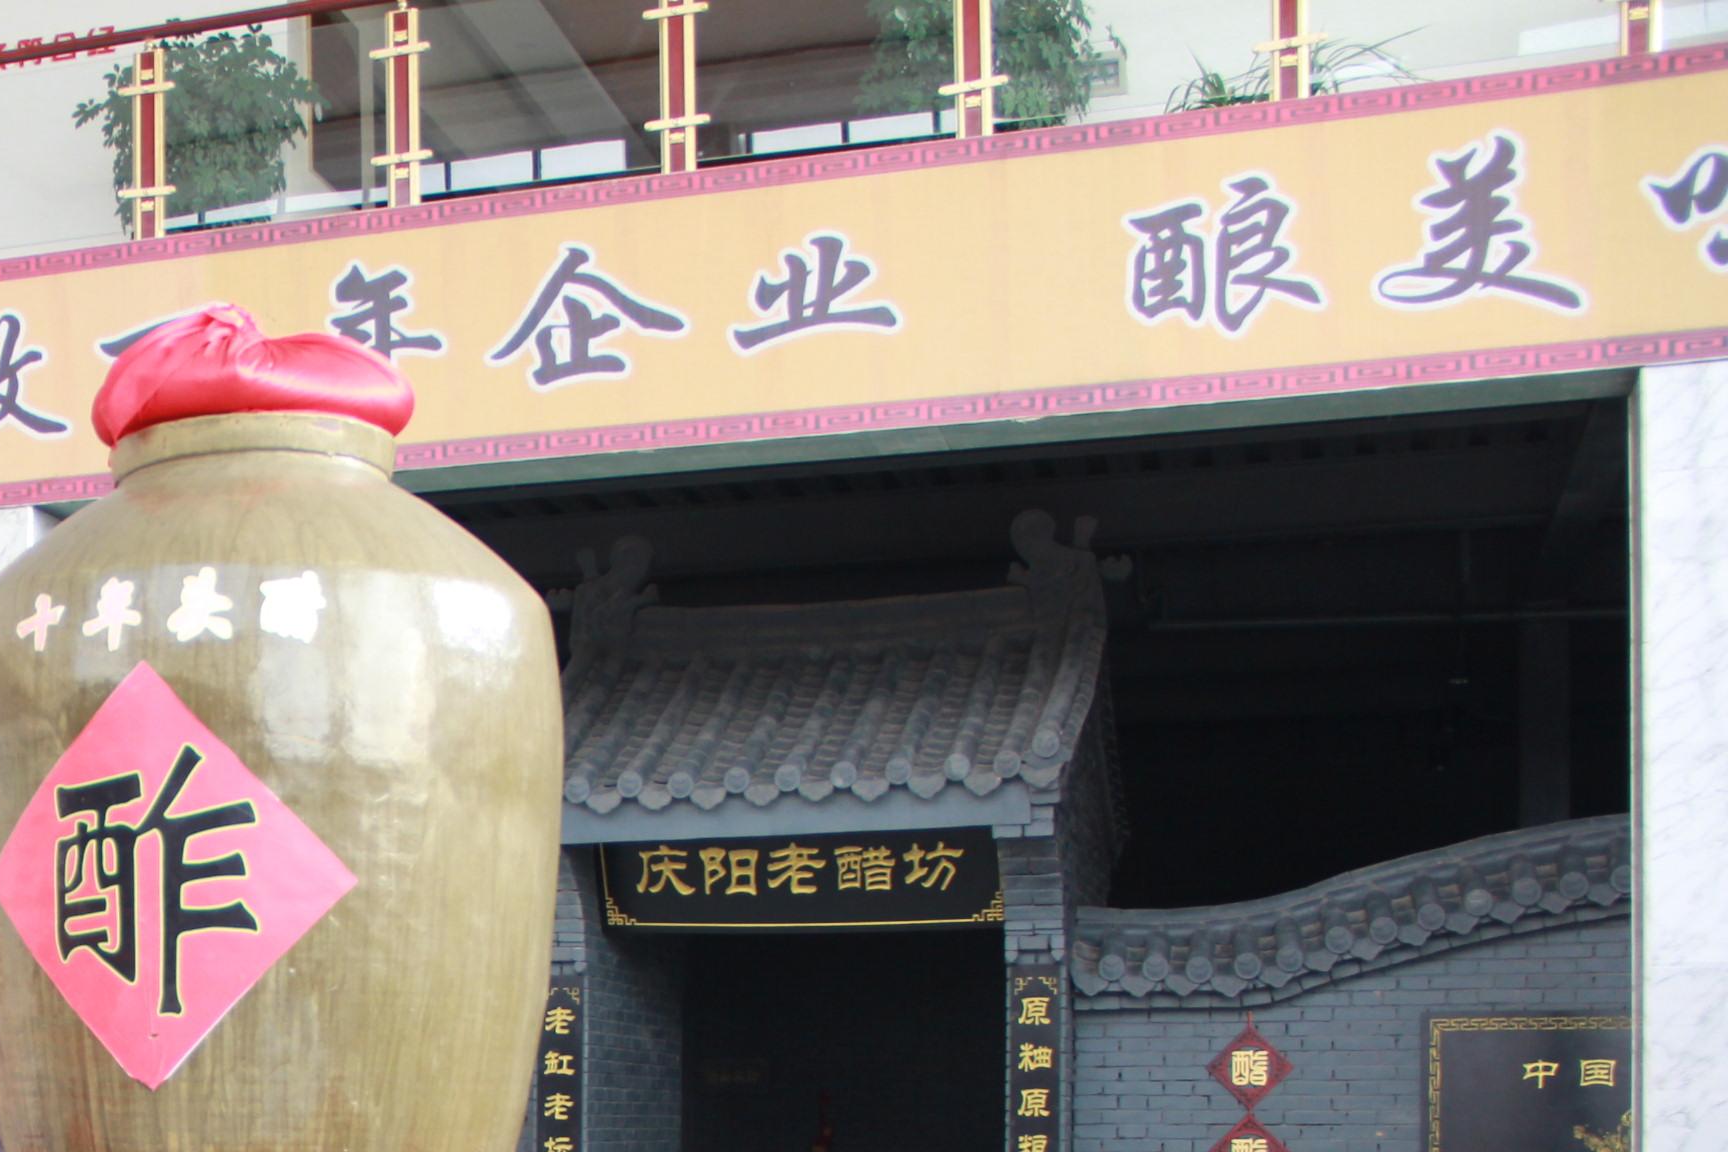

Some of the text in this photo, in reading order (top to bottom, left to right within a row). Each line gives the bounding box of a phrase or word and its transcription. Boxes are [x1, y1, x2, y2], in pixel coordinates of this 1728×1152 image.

[636, 841, 965, 895] 庆阳老醋坊
[1522, 1058, 1617, 1089] 中国
